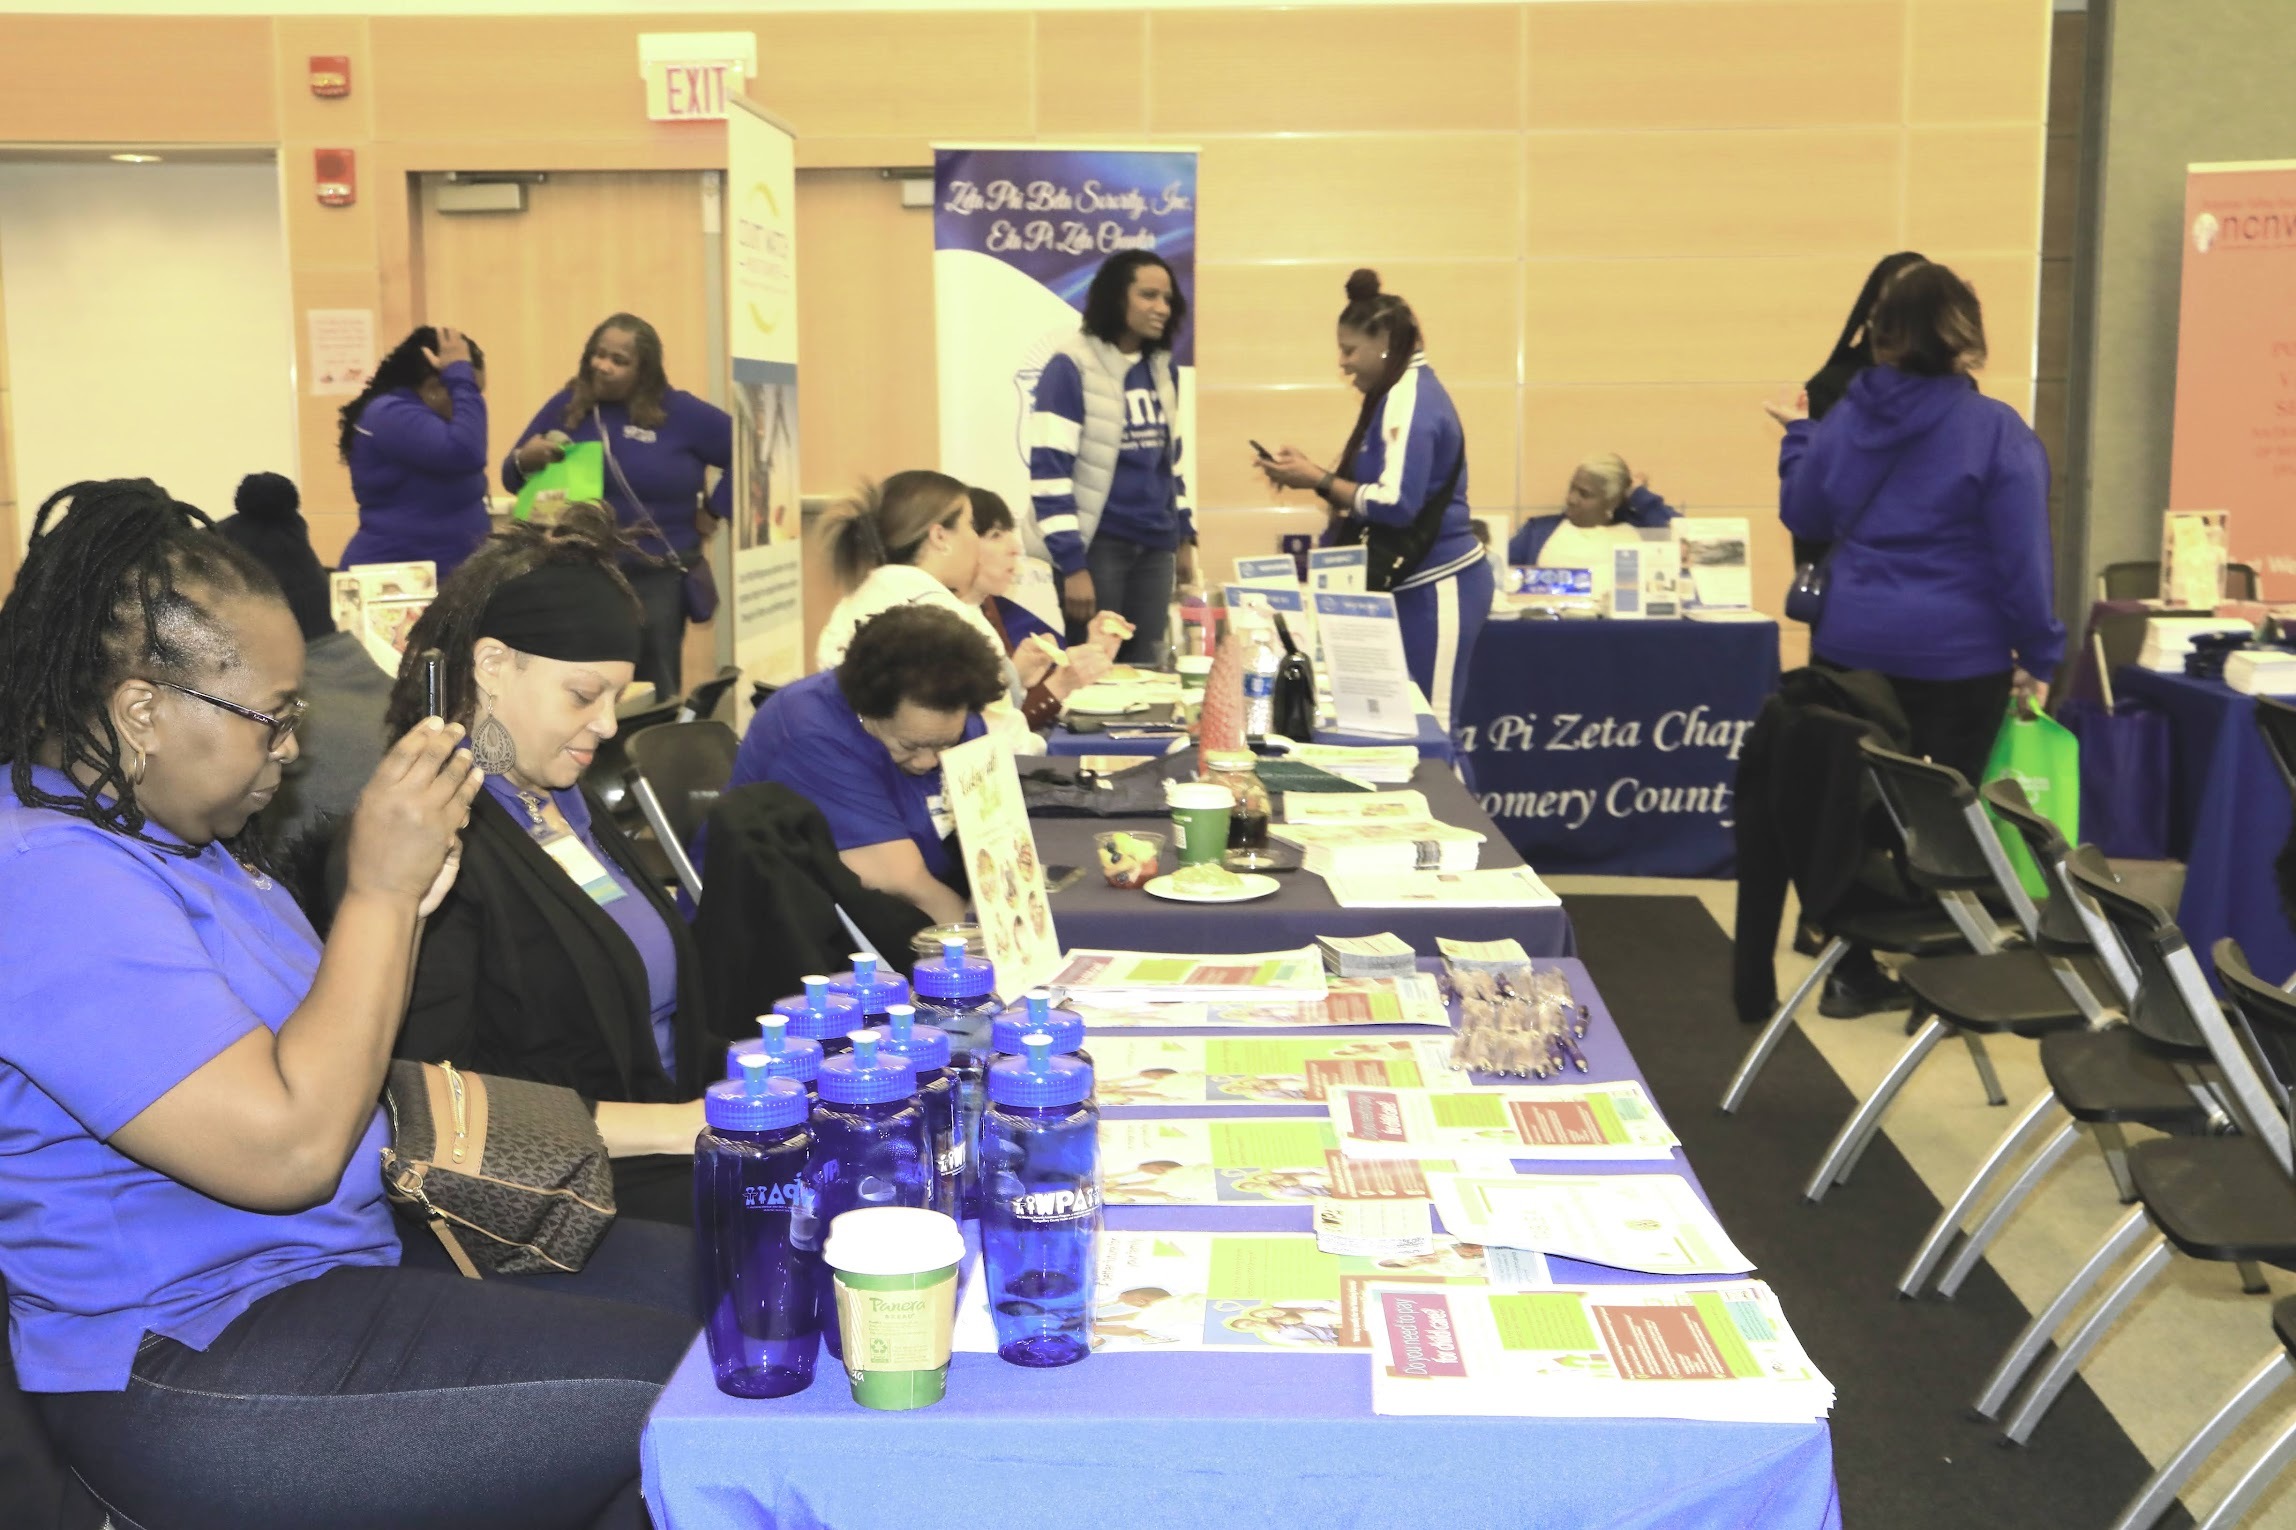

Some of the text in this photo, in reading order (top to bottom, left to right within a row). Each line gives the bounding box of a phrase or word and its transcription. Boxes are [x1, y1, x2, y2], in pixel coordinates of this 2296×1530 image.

[667, 67, 727, 114] EXIT
[945, 181, 985, 215] Zeta
[985, 180, 1023, 211] Phi
[1024, 181, 1072, 211] Beta
[986, 220, 1021, 252] Eta
[1023, 220, 1054, 252] Pi
[1055, 221, 1094, 255] Zeta
[1488, 713, 1537, 752] Pi
[1545, 714, 1641, 751] Zeta
[1478, 777, 1736, 830] omery Count
[1034, 1188, 1088, 1215] WPA
[869, 1297, 926, 1312] Panera
[1394, 1297, 1419, 1313] pay
[1394, 1324, 1420, 1344] need
[1404, 1346, 1430, 1361] you
[1429, 1350, 1458, 1363] for
[1403, 1363, 1427, 1374] Do
